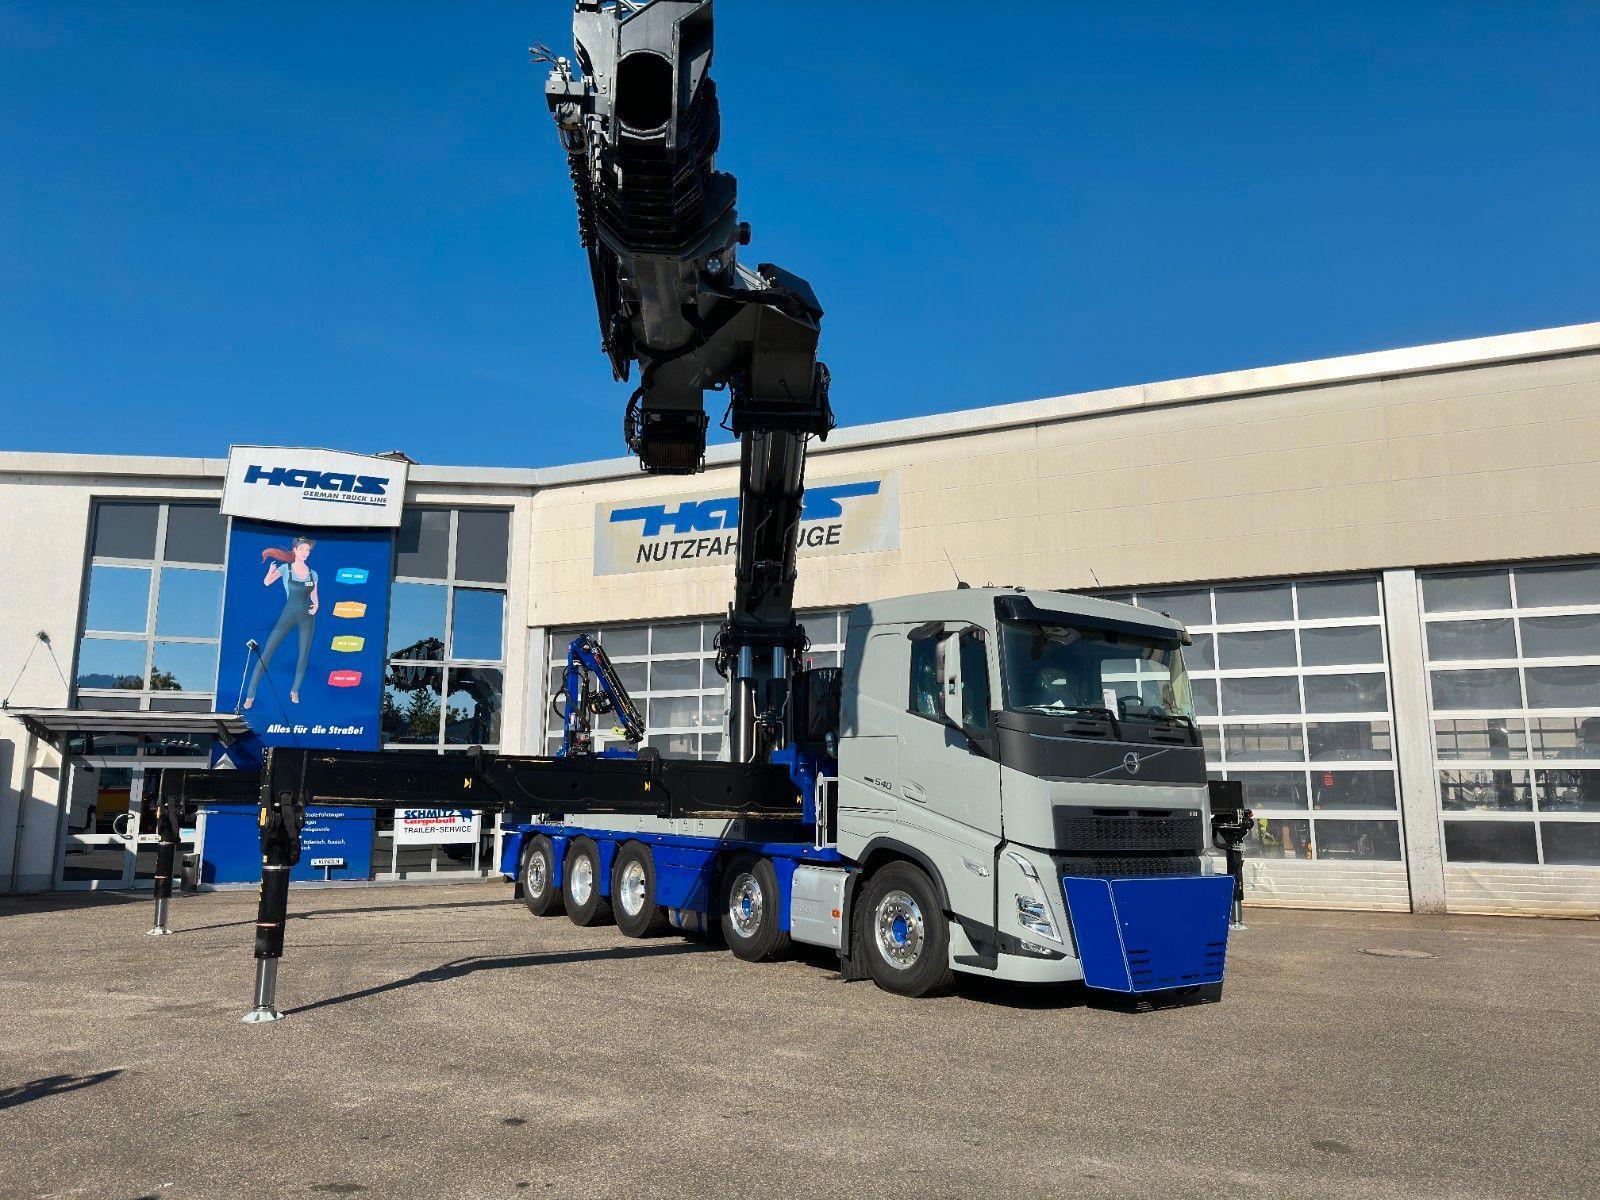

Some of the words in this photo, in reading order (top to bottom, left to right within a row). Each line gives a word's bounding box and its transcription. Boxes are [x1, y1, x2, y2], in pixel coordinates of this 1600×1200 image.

[303, 490, 339, 499] GERMAN
[341, 494, 367, 502] TRUCK
[636, 524, 842, 563] NUTZFAHGE
[267, 724, 291, 734] Alles
[293, 725, 308, 734] für
[311, 725, 326, 734] die
[328, 726, 364, 735] Straße!
[404, 809, 455, 819] SCHMITZ
[403, 818, 456, 826] Cargobull
[404, 826, 472, 834] TRAILER-SERVICE
